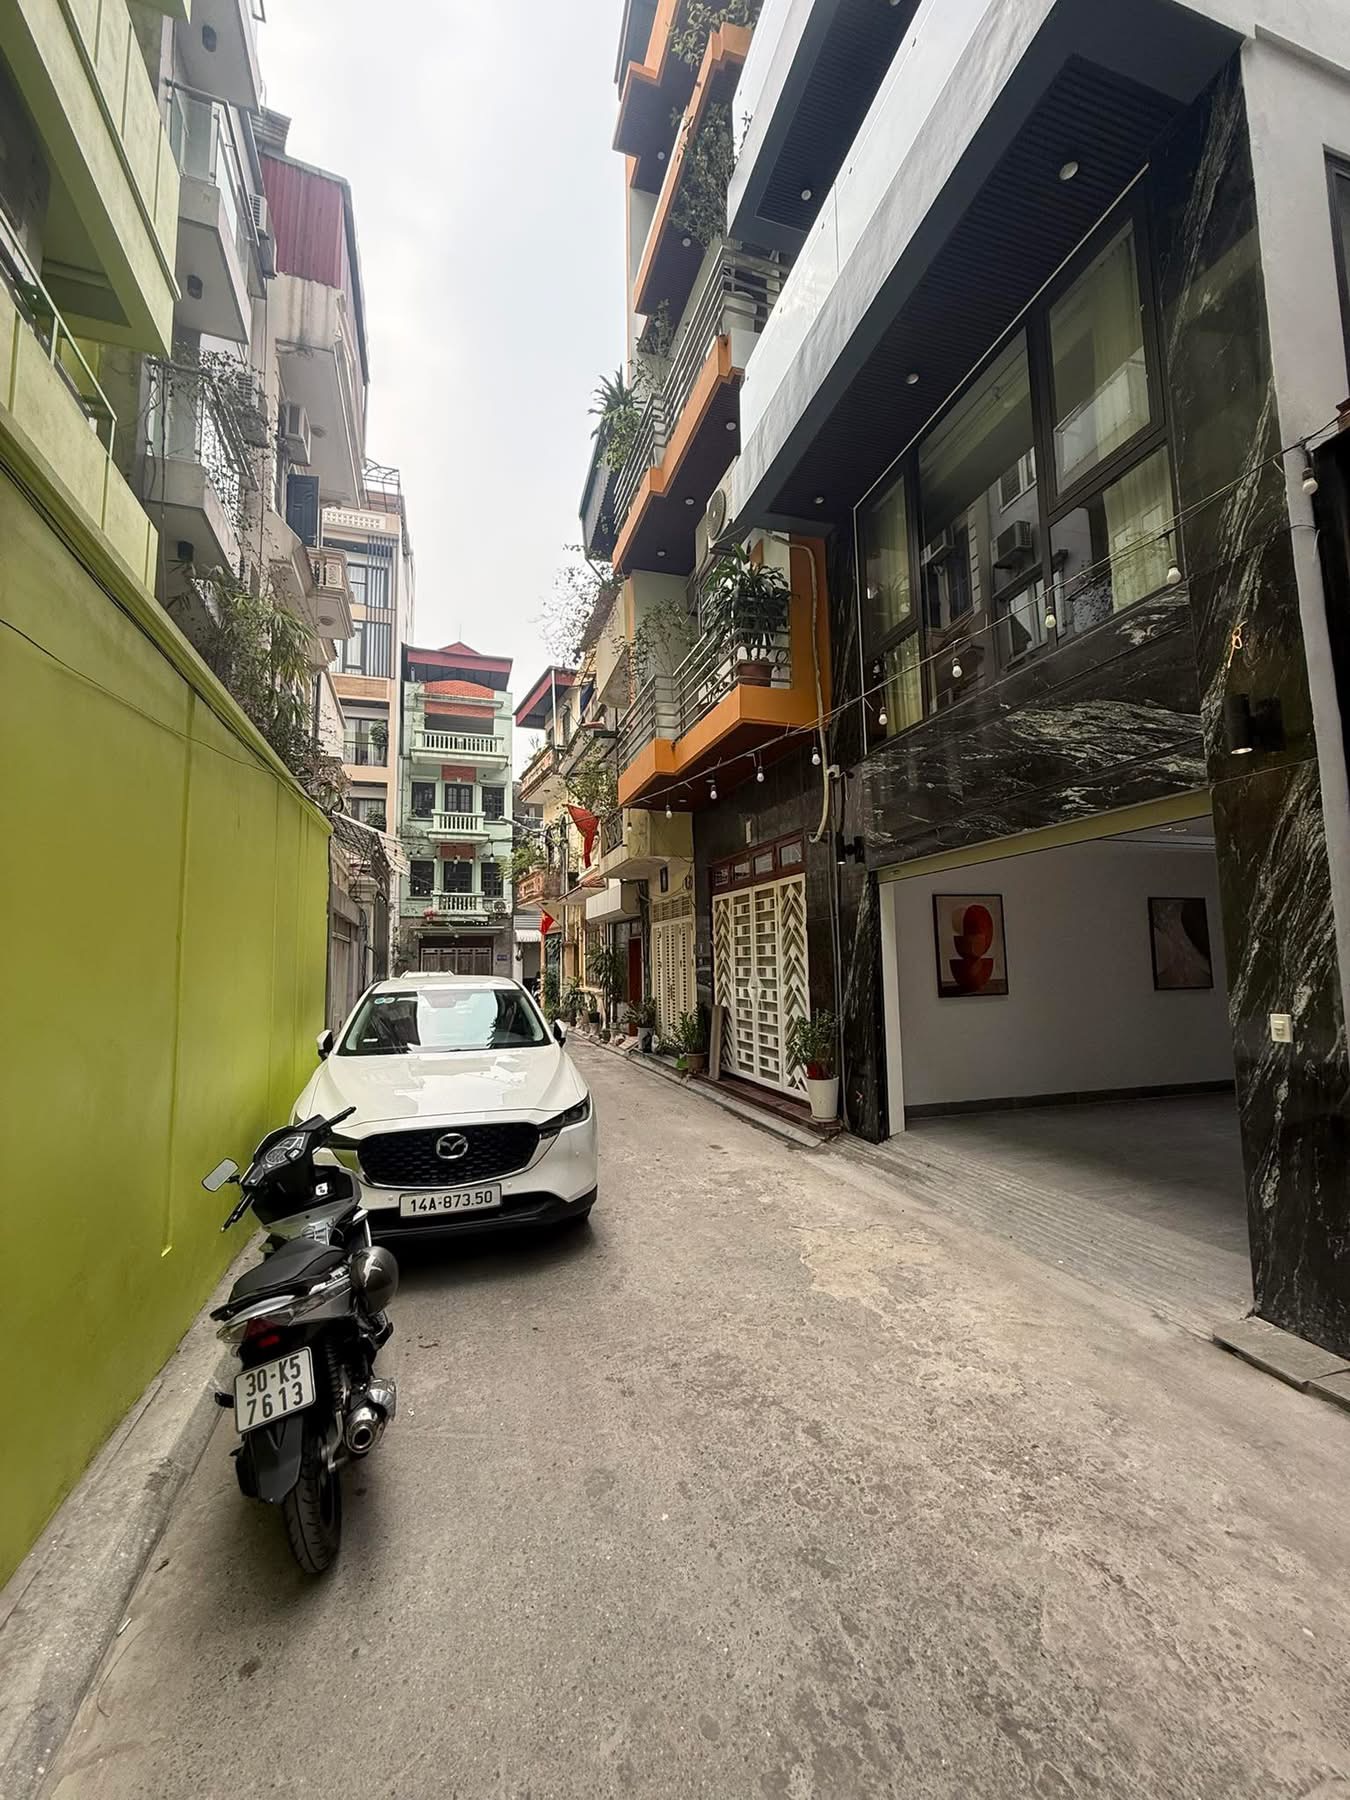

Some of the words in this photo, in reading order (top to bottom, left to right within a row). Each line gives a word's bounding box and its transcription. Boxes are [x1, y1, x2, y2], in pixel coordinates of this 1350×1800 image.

[410, 1190, 493, 1212] 14A-873.50
[246, 1354, 301, 1397] 30-K5
[246, 1381, 303, 1426] 7613
